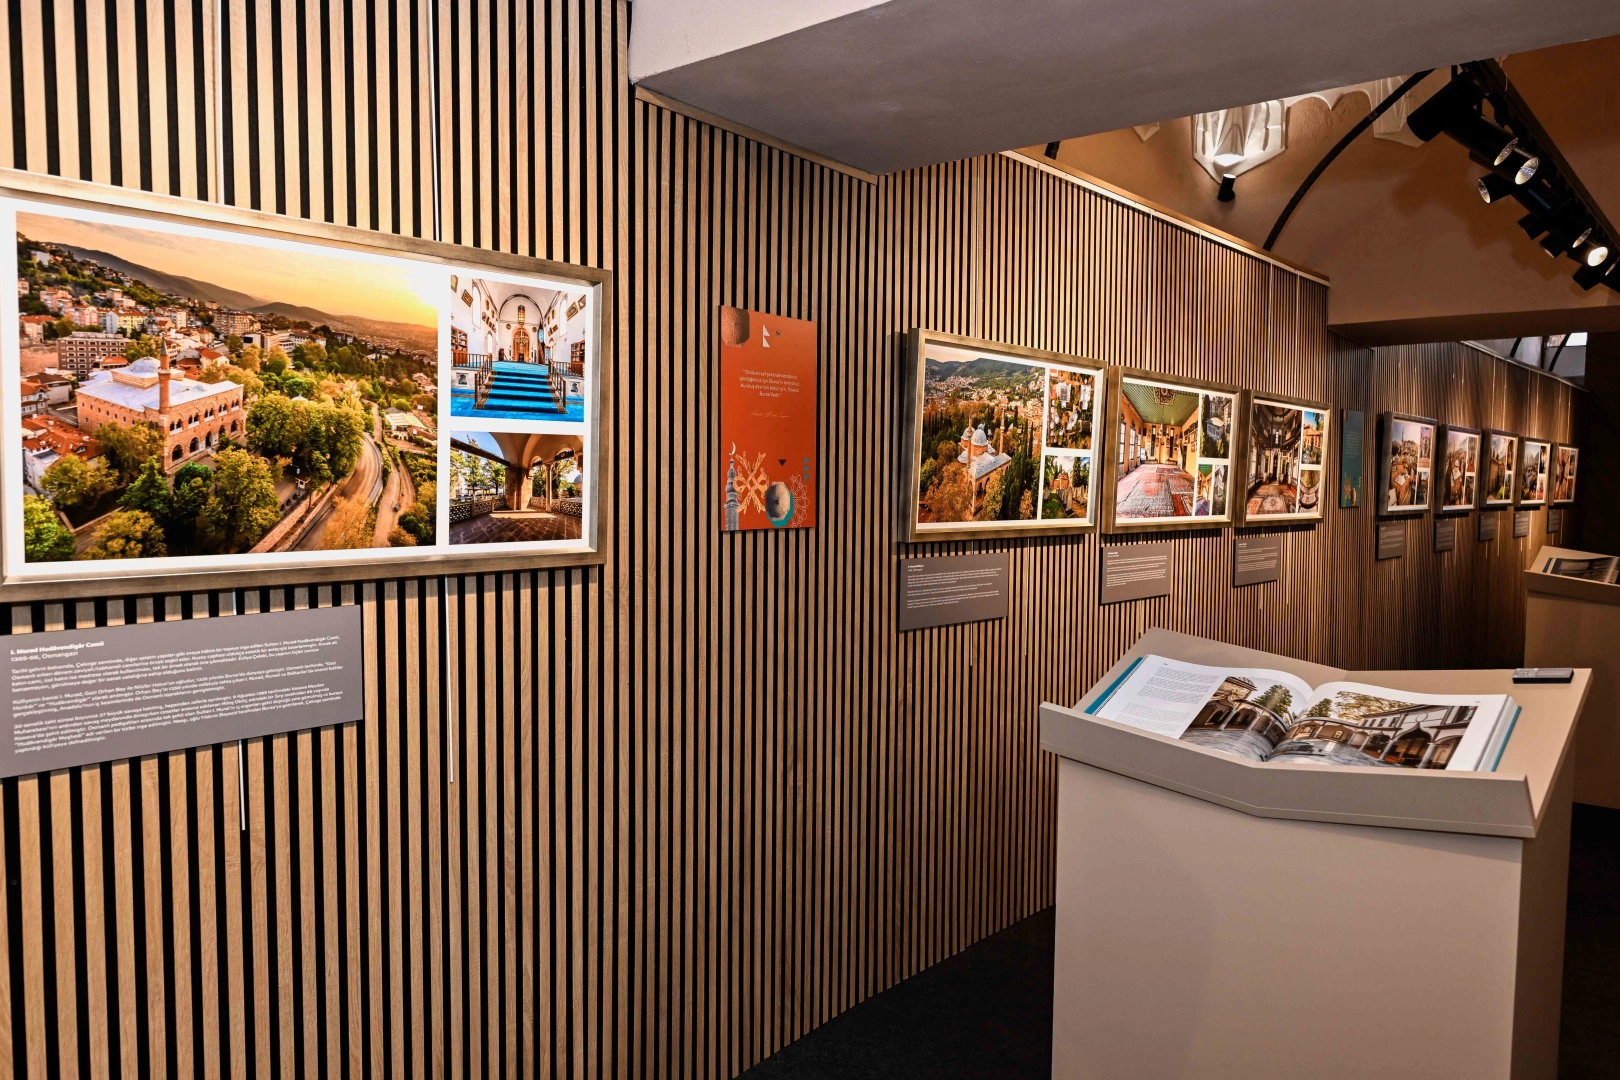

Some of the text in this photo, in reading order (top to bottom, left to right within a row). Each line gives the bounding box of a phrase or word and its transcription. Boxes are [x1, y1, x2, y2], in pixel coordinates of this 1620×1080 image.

[39, 643, 85, 653] Hudâvendigâr
[11, 651, 78, 663] 1365-66, Osmangazi
